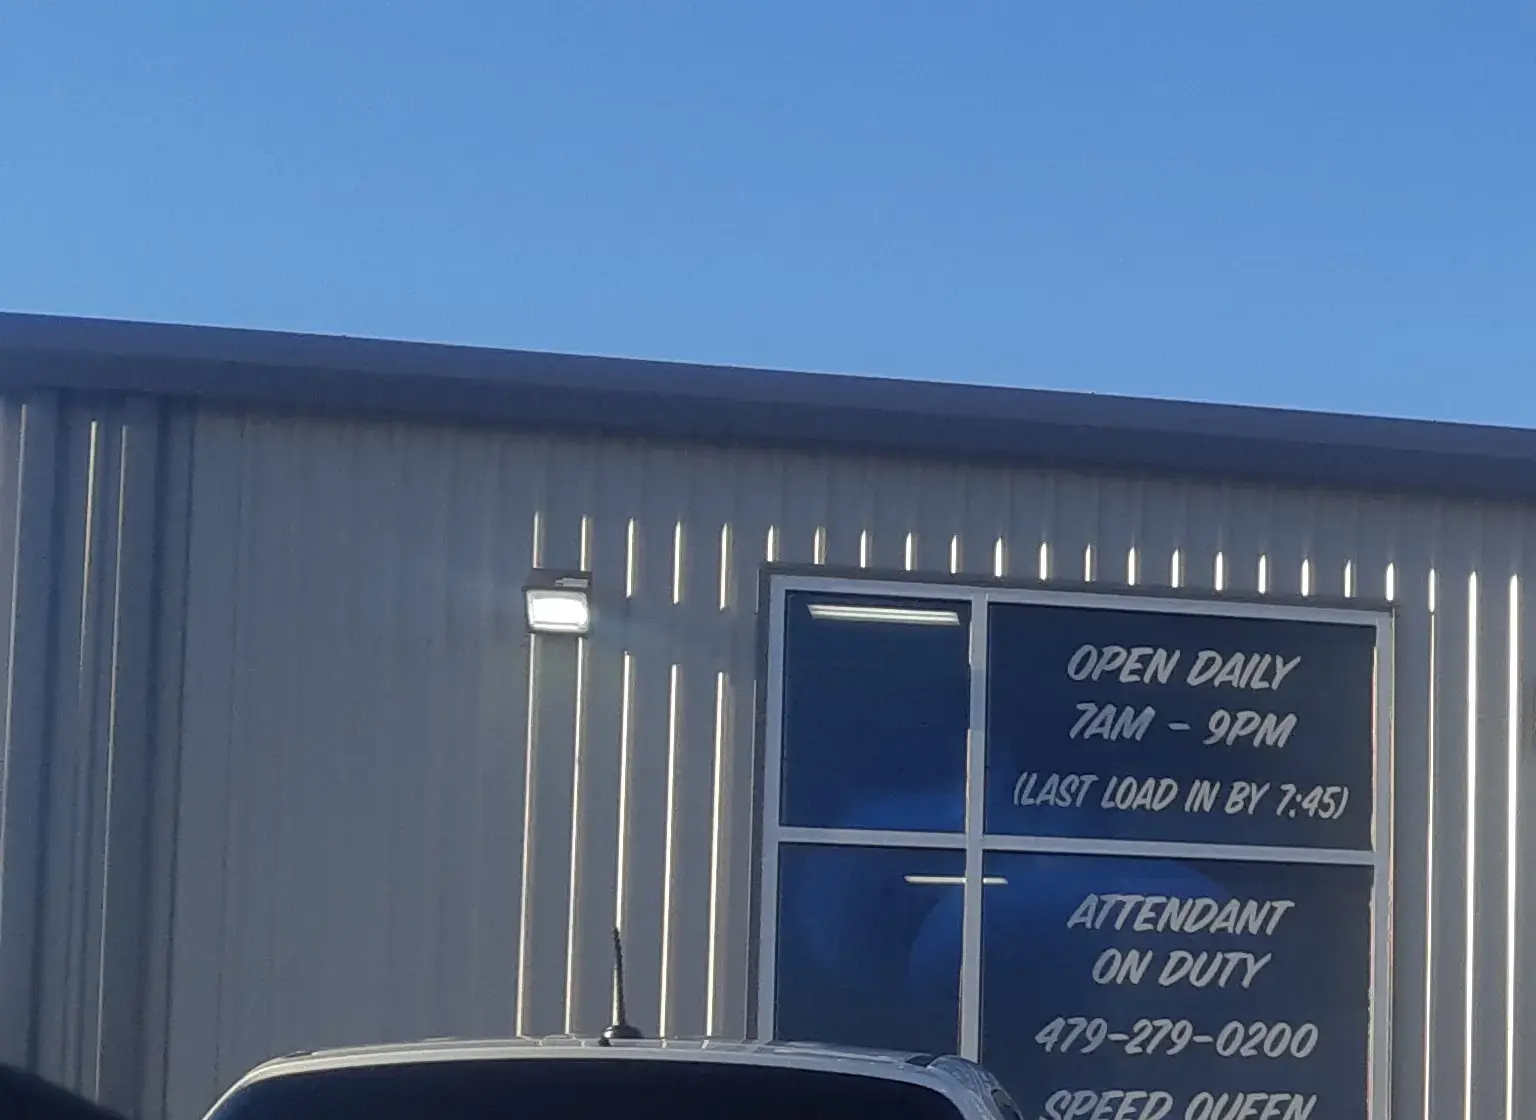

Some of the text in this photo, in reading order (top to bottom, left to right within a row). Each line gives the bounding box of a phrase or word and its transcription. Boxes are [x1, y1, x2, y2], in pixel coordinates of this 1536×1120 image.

[1067, 644, 1301, 690] OPEN DAILY
[1068, 702, 1156, 742] 7AM
[1203, 709, 1298, 748] 9PM
[1013, 771, 1350, 820] (LAST LOAD IN BY 7:45)
[1067, 893, 1296, 936] ATTENDANT
[1091, 947, 1272, 989] ON DUTY
[1034, 1016, 1319, 1059] 479-279-0200
